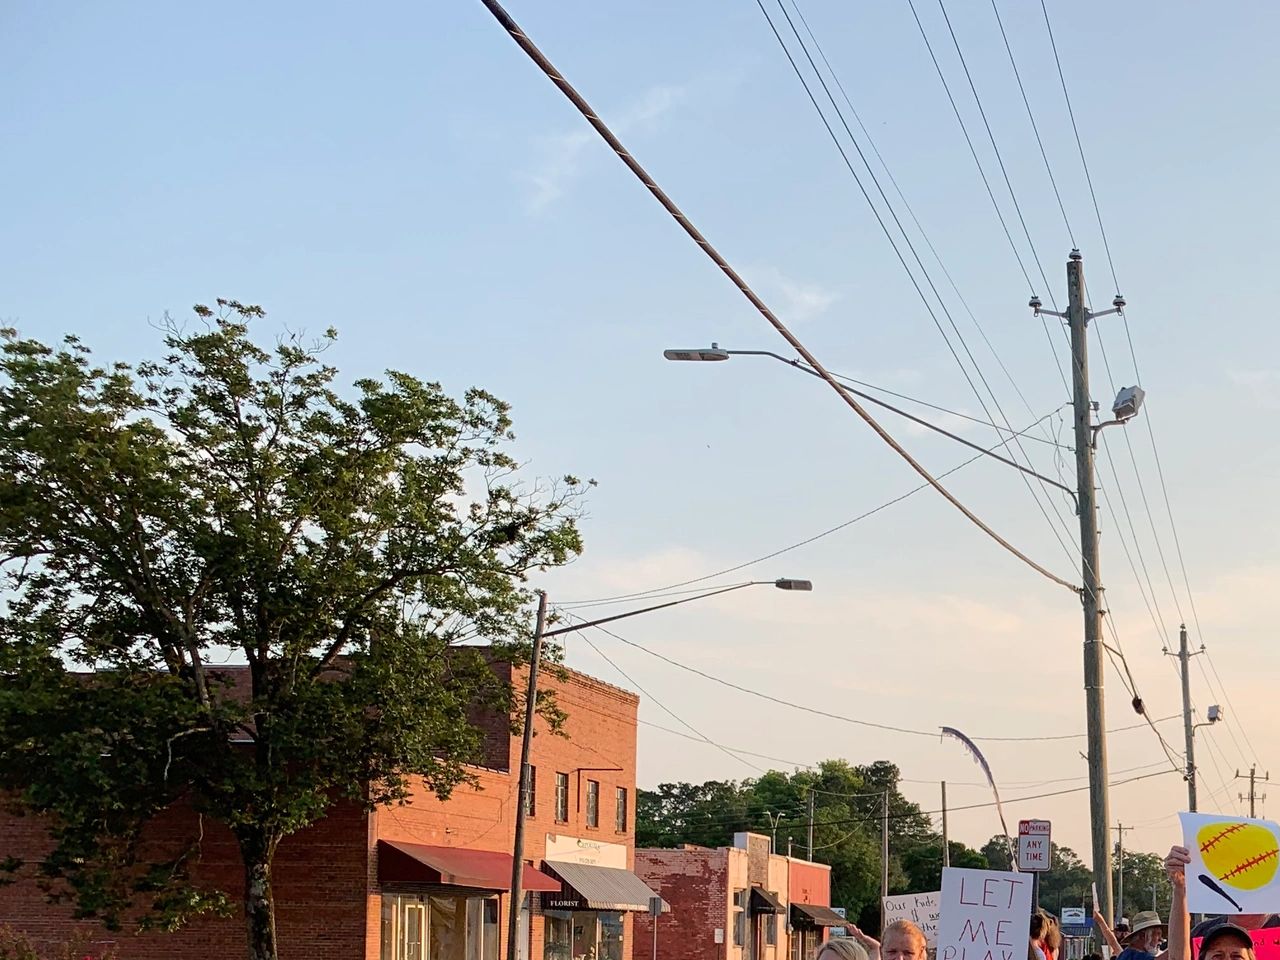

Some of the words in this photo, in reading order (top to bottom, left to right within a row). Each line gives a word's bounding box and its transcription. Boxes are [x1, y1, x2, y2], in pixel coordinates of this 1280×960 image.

[1019, 822, 1029, 833] NO
[1029, 824, 1050, 832] PARKING
[1026, 841, 1043, 849] ANY
[1026, 852, 1043, 861] TIME
[959, 876, 1024, 910] LET
[550, 900, 580, 908] FLORIST
[958, 918, 1014, 947] ME
